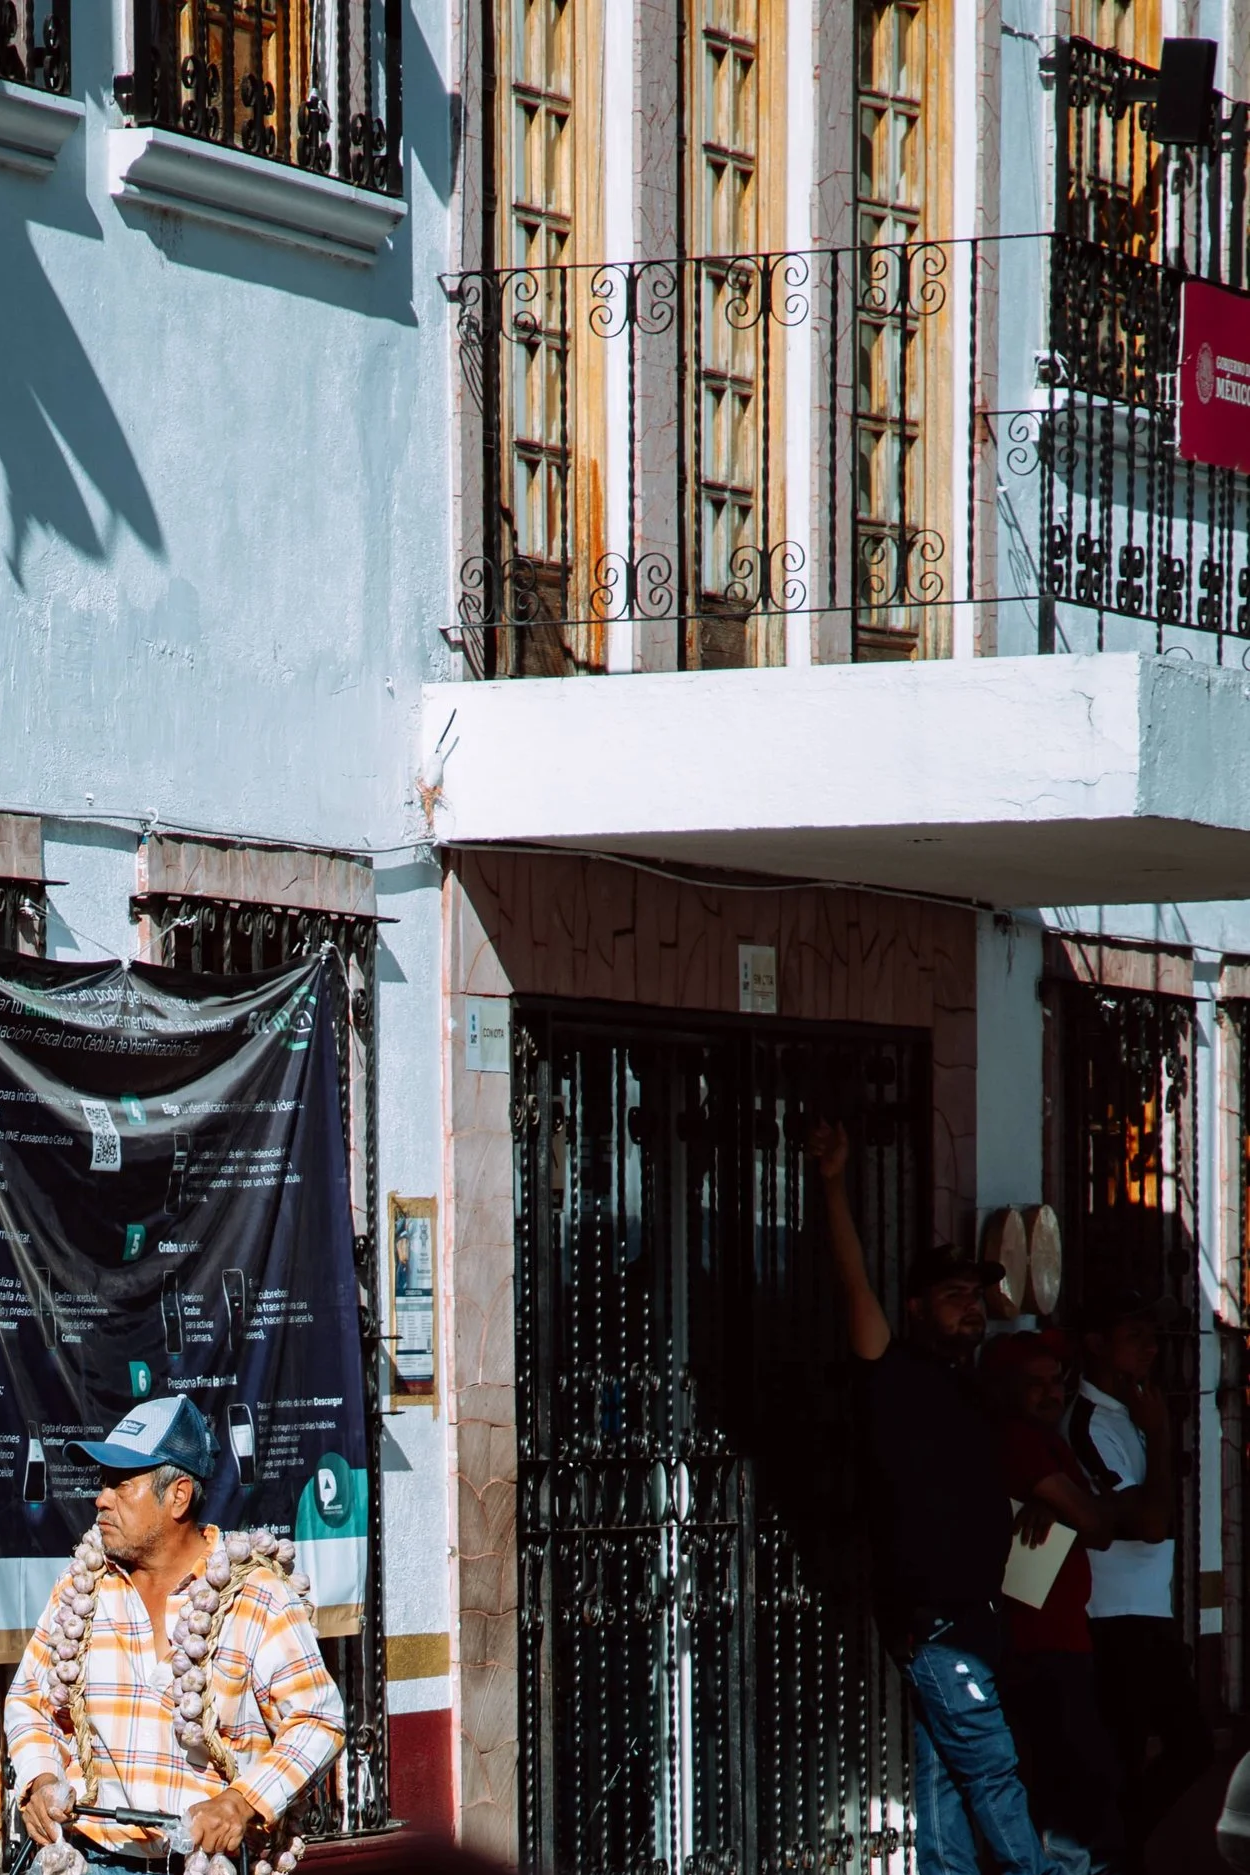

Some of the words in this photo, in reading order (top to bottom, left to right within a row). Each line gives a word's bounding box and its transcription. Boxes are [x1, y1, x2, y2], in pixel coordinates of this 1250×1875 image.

[11, 997, 23, 1014] tu
[32, 1026, 65, 1047] Fiscal
[62, 1034, 83, 1049] con
[83, 1033, 115, 1053] Cédula
[115, 1035, 128, 1055] de
[128, 1037, 182, 1057] Identificación
[16, 1088, 37, 1103] iniciar
[161, 1101, 180, 1117] Elige
[248, 1164, 260, 1174] por
[242, 1178, 253, 1189] por
[253, 1178, 263, 1187] un
[130, 1233, 141, 1256] 5
[158, 1240, 178, 1254] Graba
[178, 1243, 188, 1254] un
[262, 1302, 280, 1312] frase
[138, 1369, 146, 1392] 6
[167, 1376, 196, 1390] Presiona
[313, 1397, 343, 1408] Descargar
